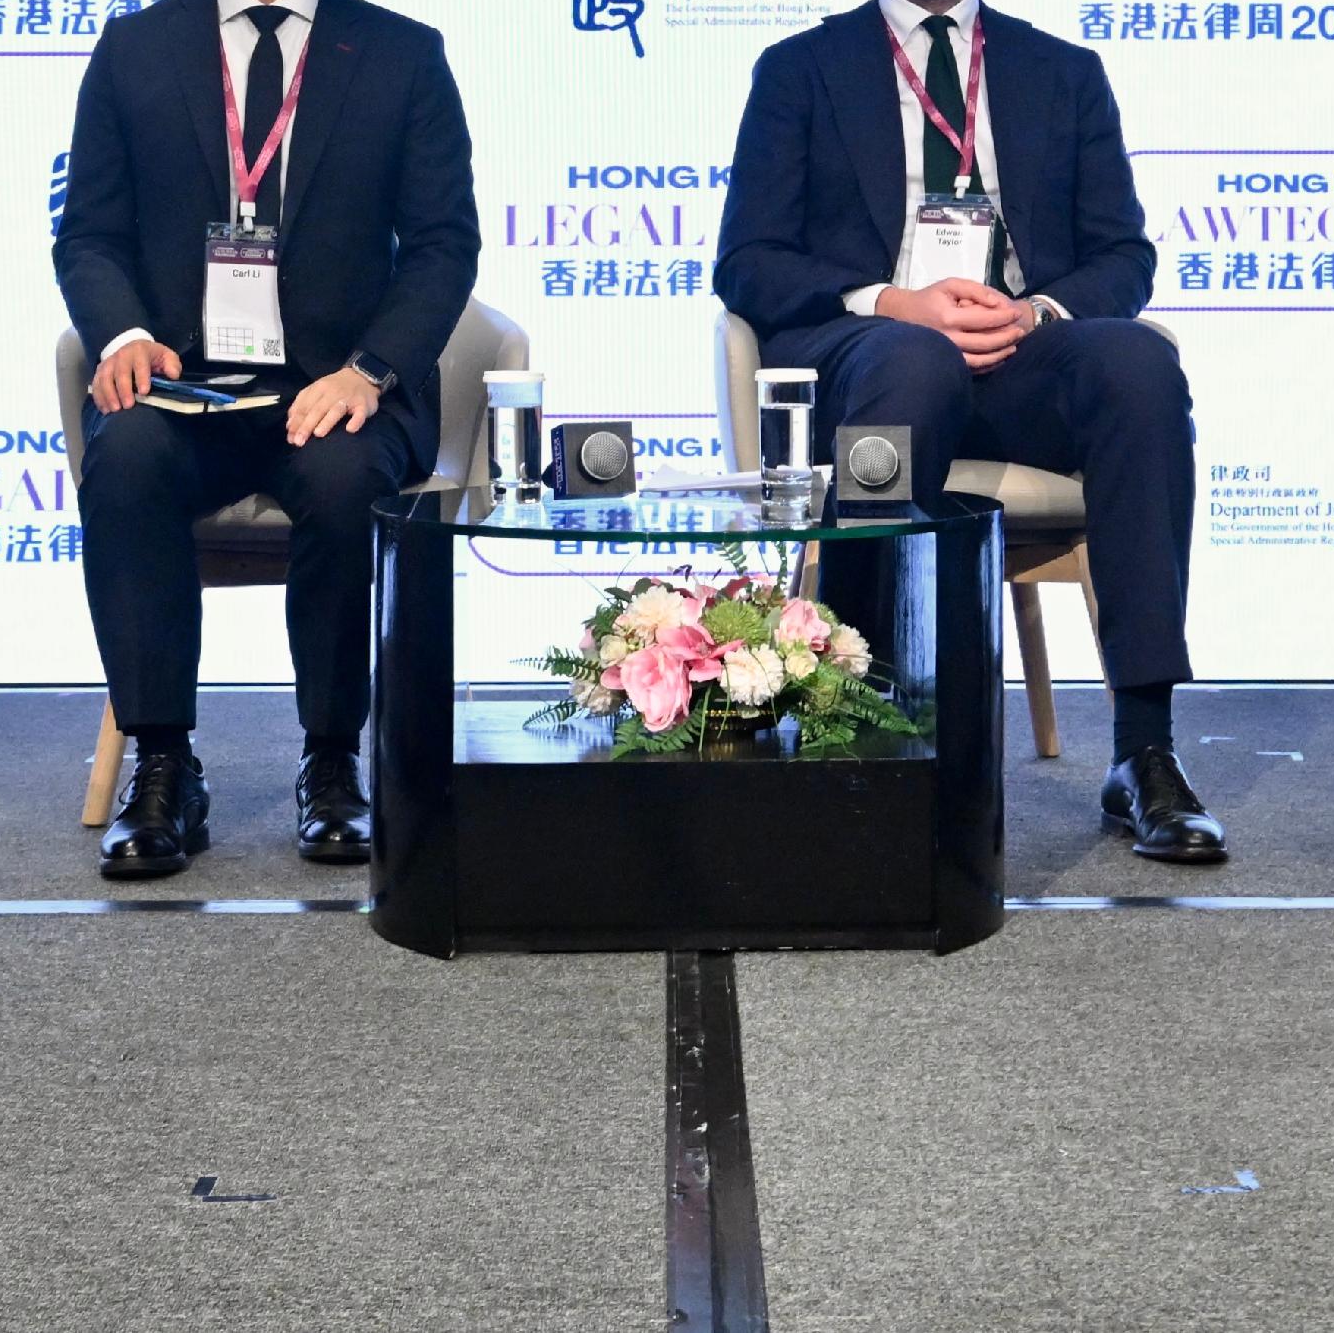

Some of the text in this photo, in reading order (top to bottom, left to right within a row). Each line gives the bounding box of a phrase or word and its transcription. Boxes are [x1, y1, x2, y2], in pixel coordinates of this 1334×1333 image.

[569, 166, 699, 189] HONG
[1216, 173, 1329, 193] HONG
[506, 204, 704, 246] LEGAL
[1211, 466, 1270, 481] 律政司
[1211, 503, 1298, 520] Department
[1305, 502, 1320, 516] of
